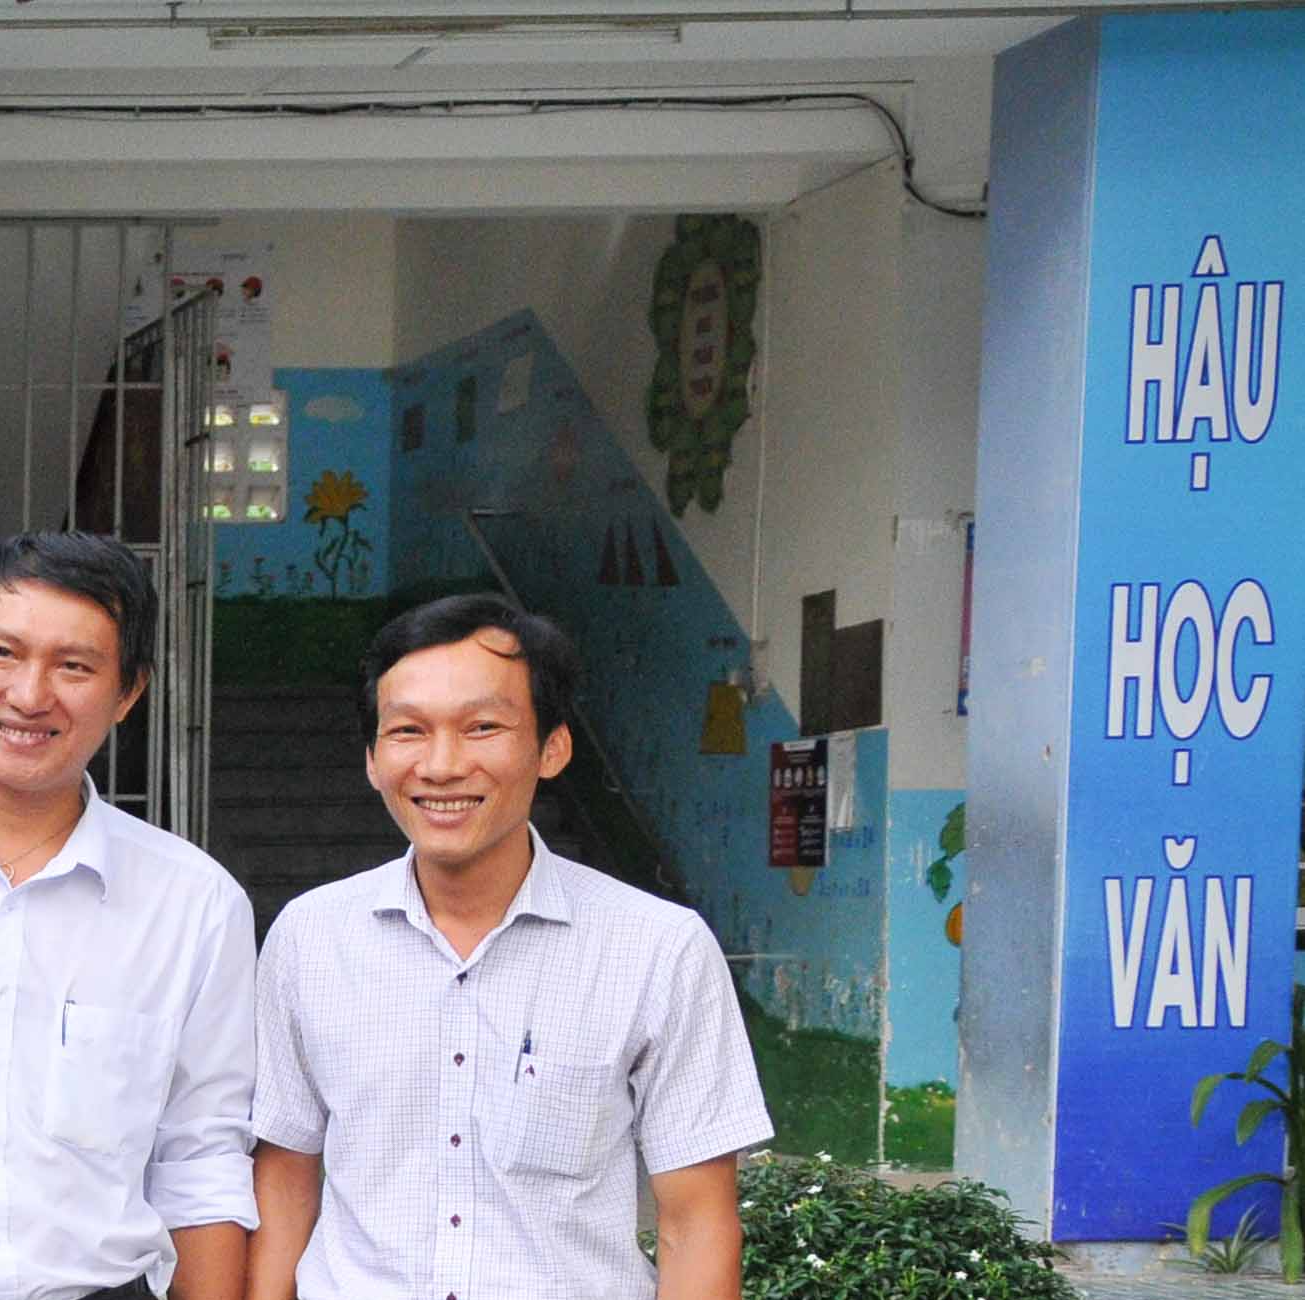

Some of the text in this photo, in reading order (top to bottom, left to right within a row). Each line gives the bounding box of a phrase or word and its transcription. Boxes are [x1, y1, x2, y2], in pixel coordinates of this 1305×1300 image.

[1124, 235, 1284, 492] HẬU
[1104, 578, 1274, 786] HỌC
[1103, 835, 1254, 1030] VĂN
